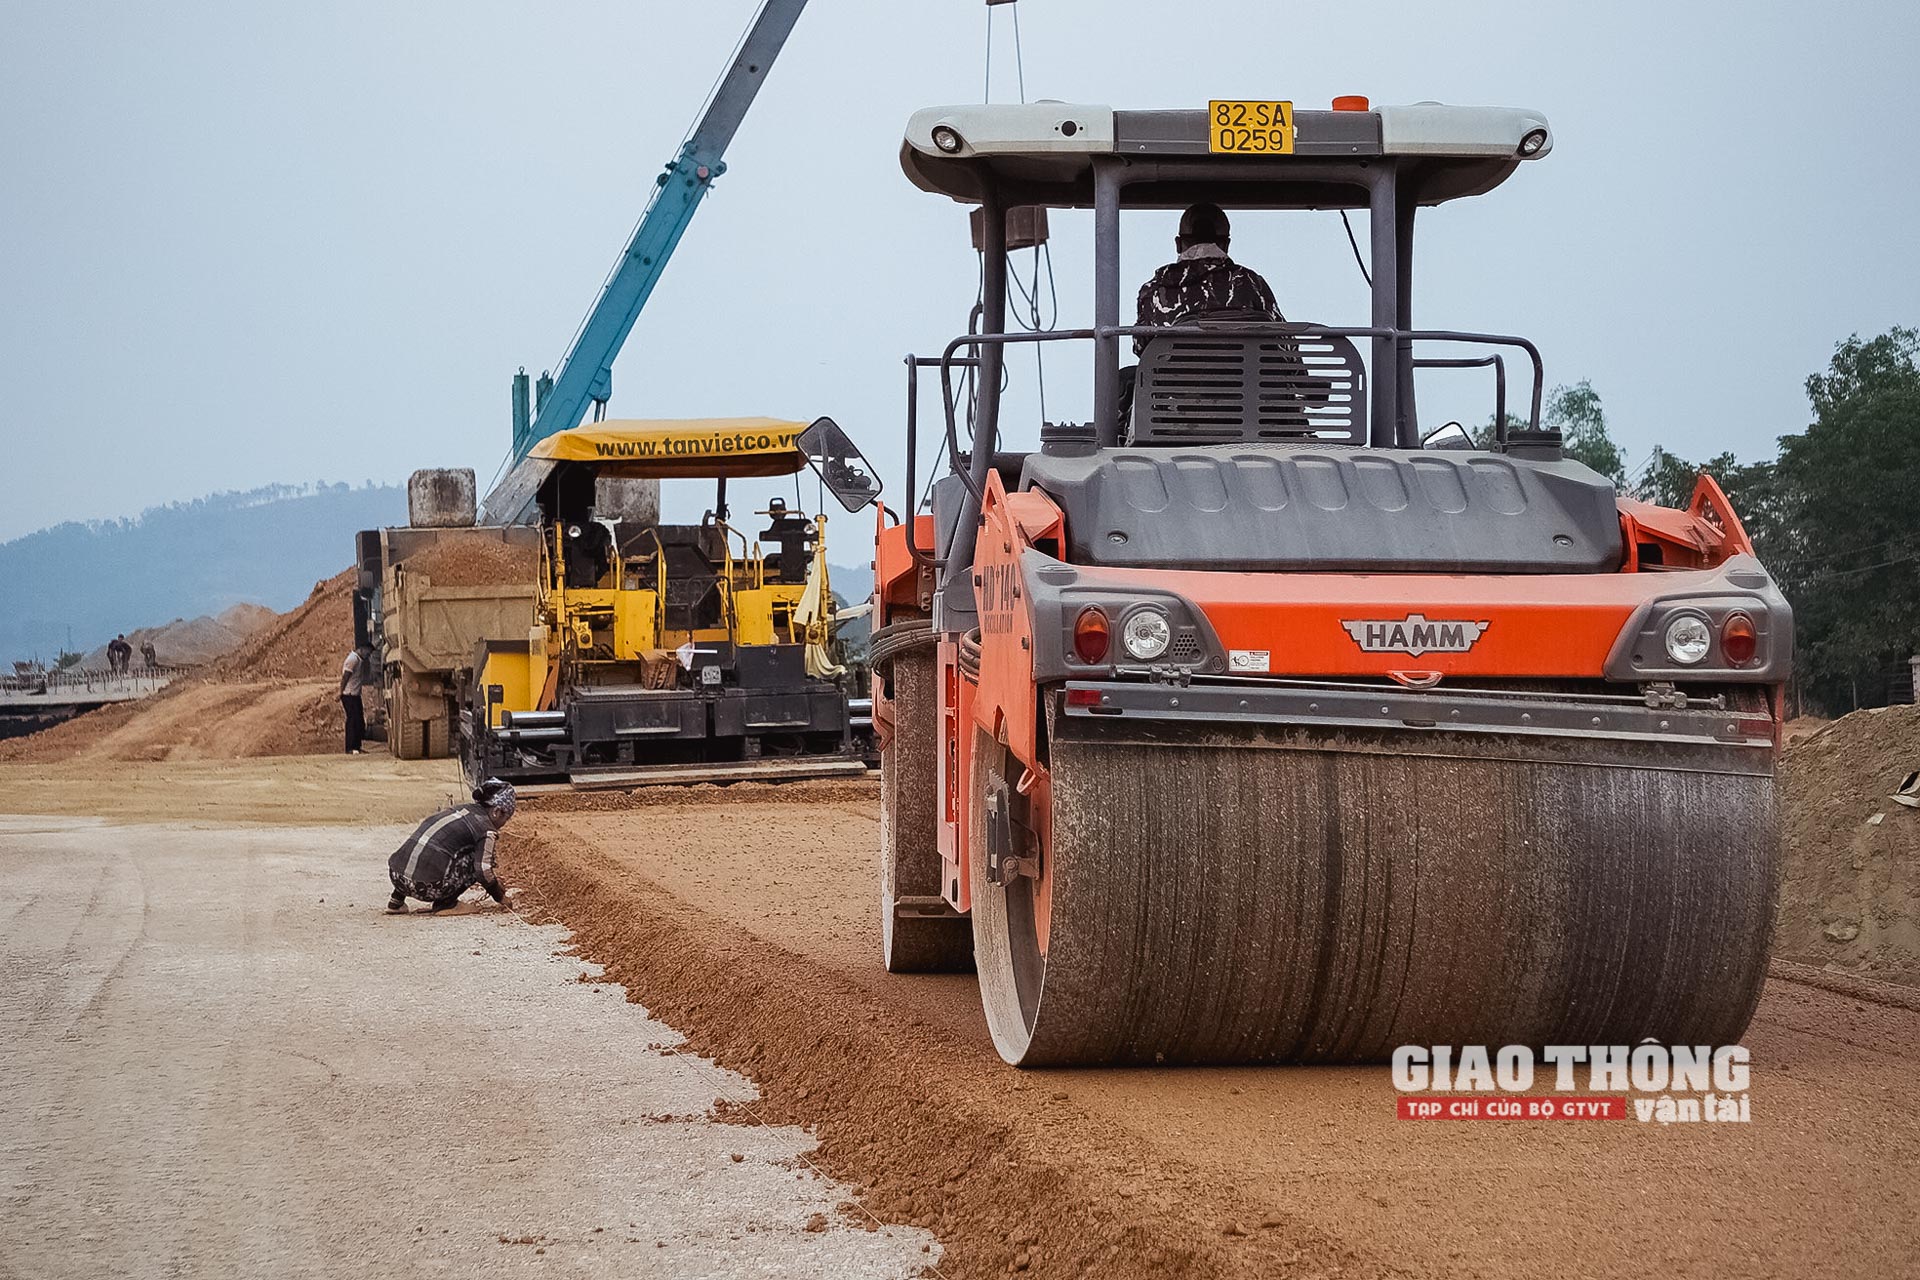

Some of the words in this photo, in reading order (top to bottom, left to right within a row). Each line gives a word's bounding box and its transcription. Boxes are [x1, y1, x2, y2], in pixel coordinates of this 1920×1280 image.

[1216, 104, 1287, 127] 82-SA
[1220, 129, 1283, 151] 0259
[1365, 624, 1465, 648] HAMM
